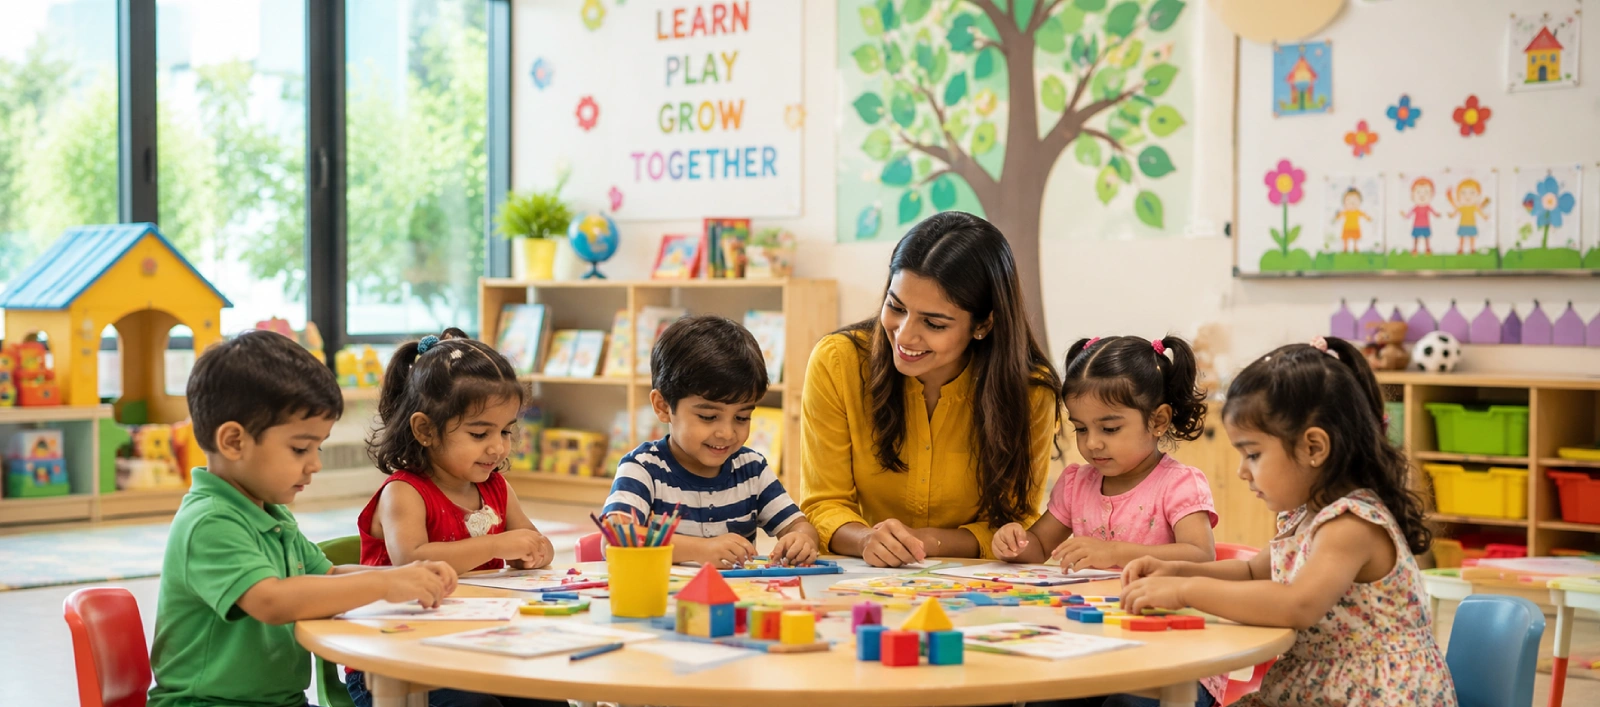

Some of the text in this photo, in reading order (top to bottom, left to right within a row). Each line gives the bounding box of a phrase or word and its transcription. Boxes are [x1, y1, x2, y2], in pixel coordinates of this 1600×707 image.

[656, 1, 750, 41] LEARN
[666, 50, 738, 87] PLAY
[658, 99, 744, 134] GROW
[631, 146, 778, 182] TOGETHER
